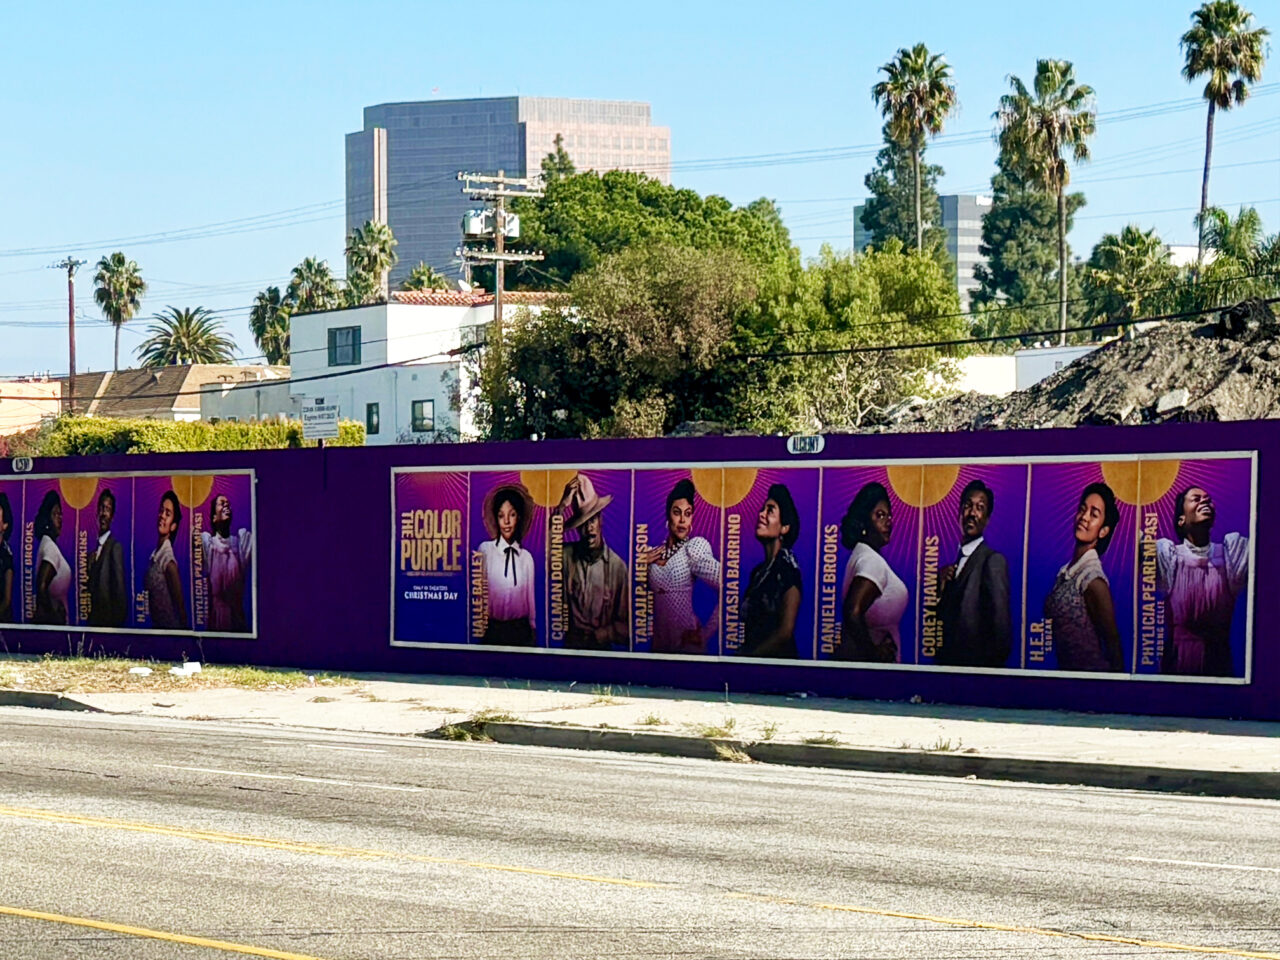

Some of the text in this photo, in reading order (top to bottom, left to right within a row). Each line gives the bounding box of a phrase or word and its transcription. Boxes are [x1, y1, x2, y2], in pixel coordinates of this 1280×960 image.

[400, 539, 462, 571] PURPLE
[401, 510, 414, 538] THE
[414, 509, 462, 539] COLOR
[404, 591, 458, 600] CHRISTMAS DAY
[472, 550, 483, 637] HALLE BAILEY
[552, 515, 564, 640] COLMAN DOMINGO
[636, 524, 648, 644] TARAJI P. HENSON
[726, 514, 741, 649] FANTASIA BARRINO
[821, 524, 838, 654] DANIELLE BROOKS
[922, 535, 939, 656] COREY HAWKINS
[1142, 512, 1158, 665] PHYLICIA PEARL MPASI
[1030, 618, 1044, 662] H.E.R.
